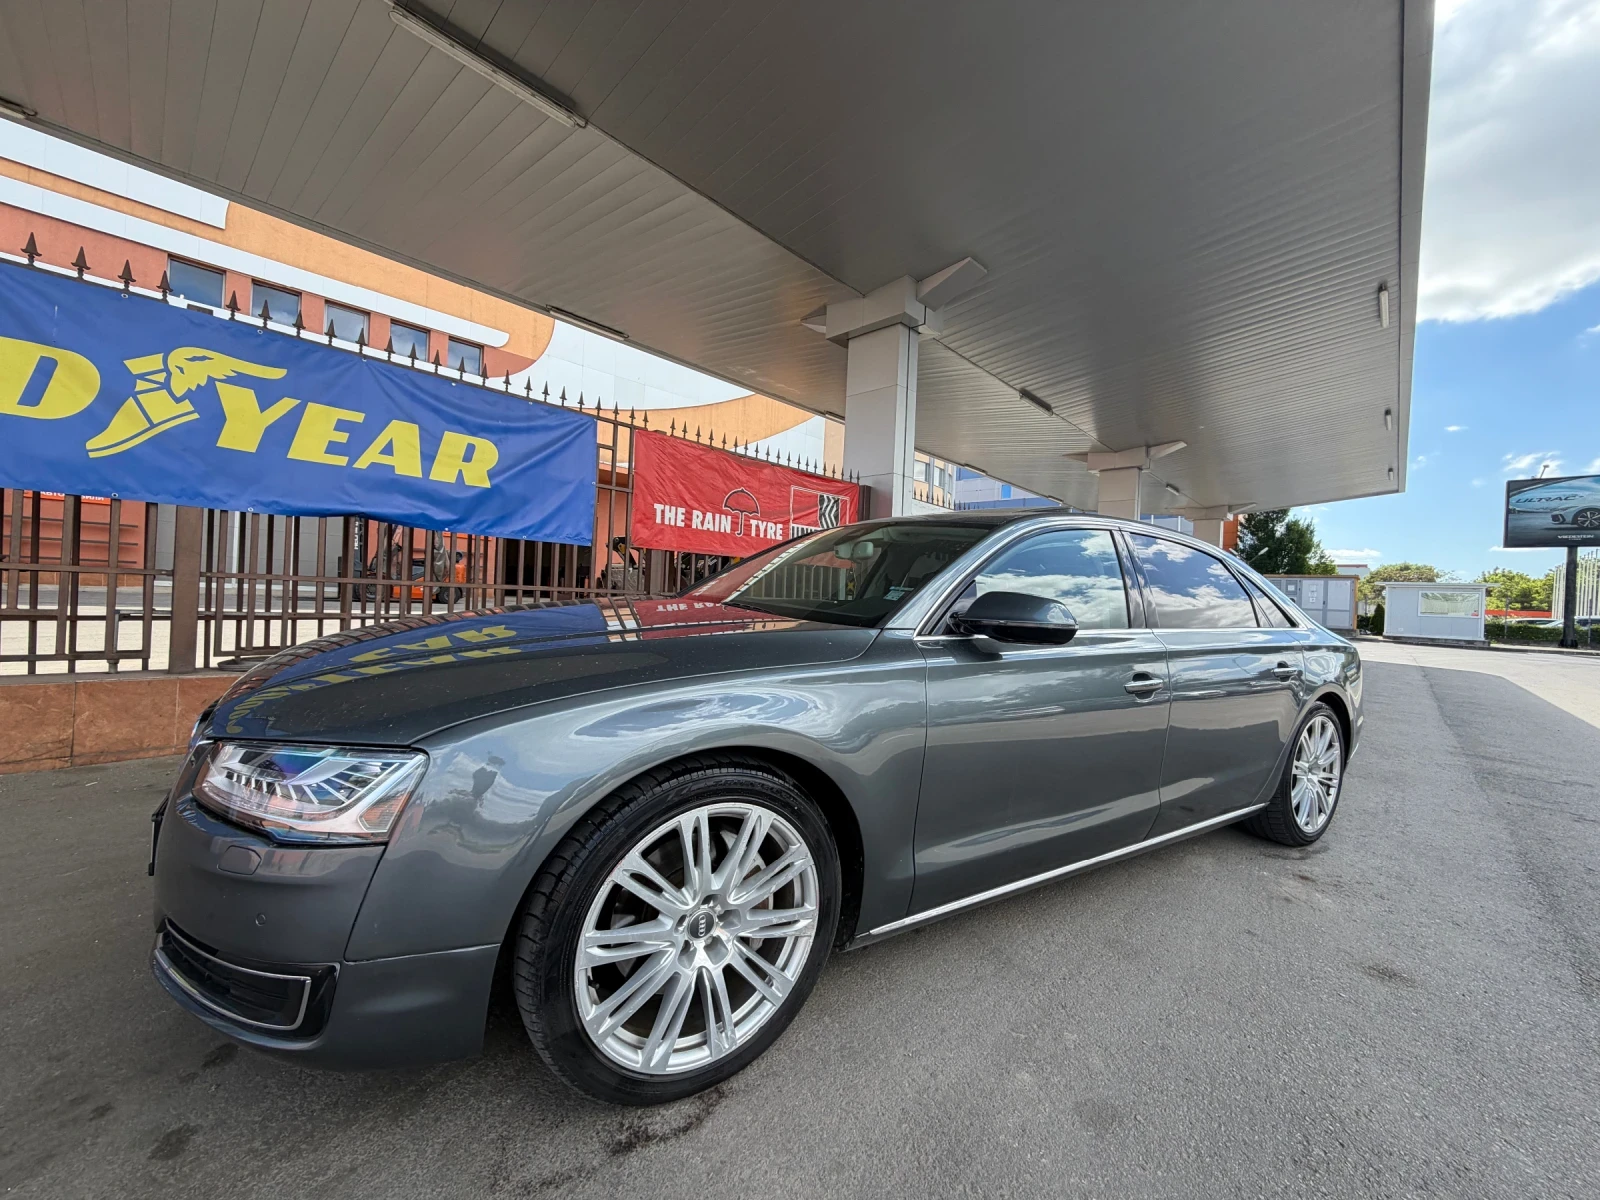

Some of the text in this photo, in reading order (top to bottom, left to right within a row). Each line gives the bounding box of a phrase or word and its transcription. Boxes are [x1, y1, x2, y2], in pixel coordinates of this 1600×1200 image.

[215, 381, 499, 488] YEAR
[654, 503, 686, 528] THE
[692, 509, 732, 534] RAIN
[750, 519, 783, 541] TYRE
